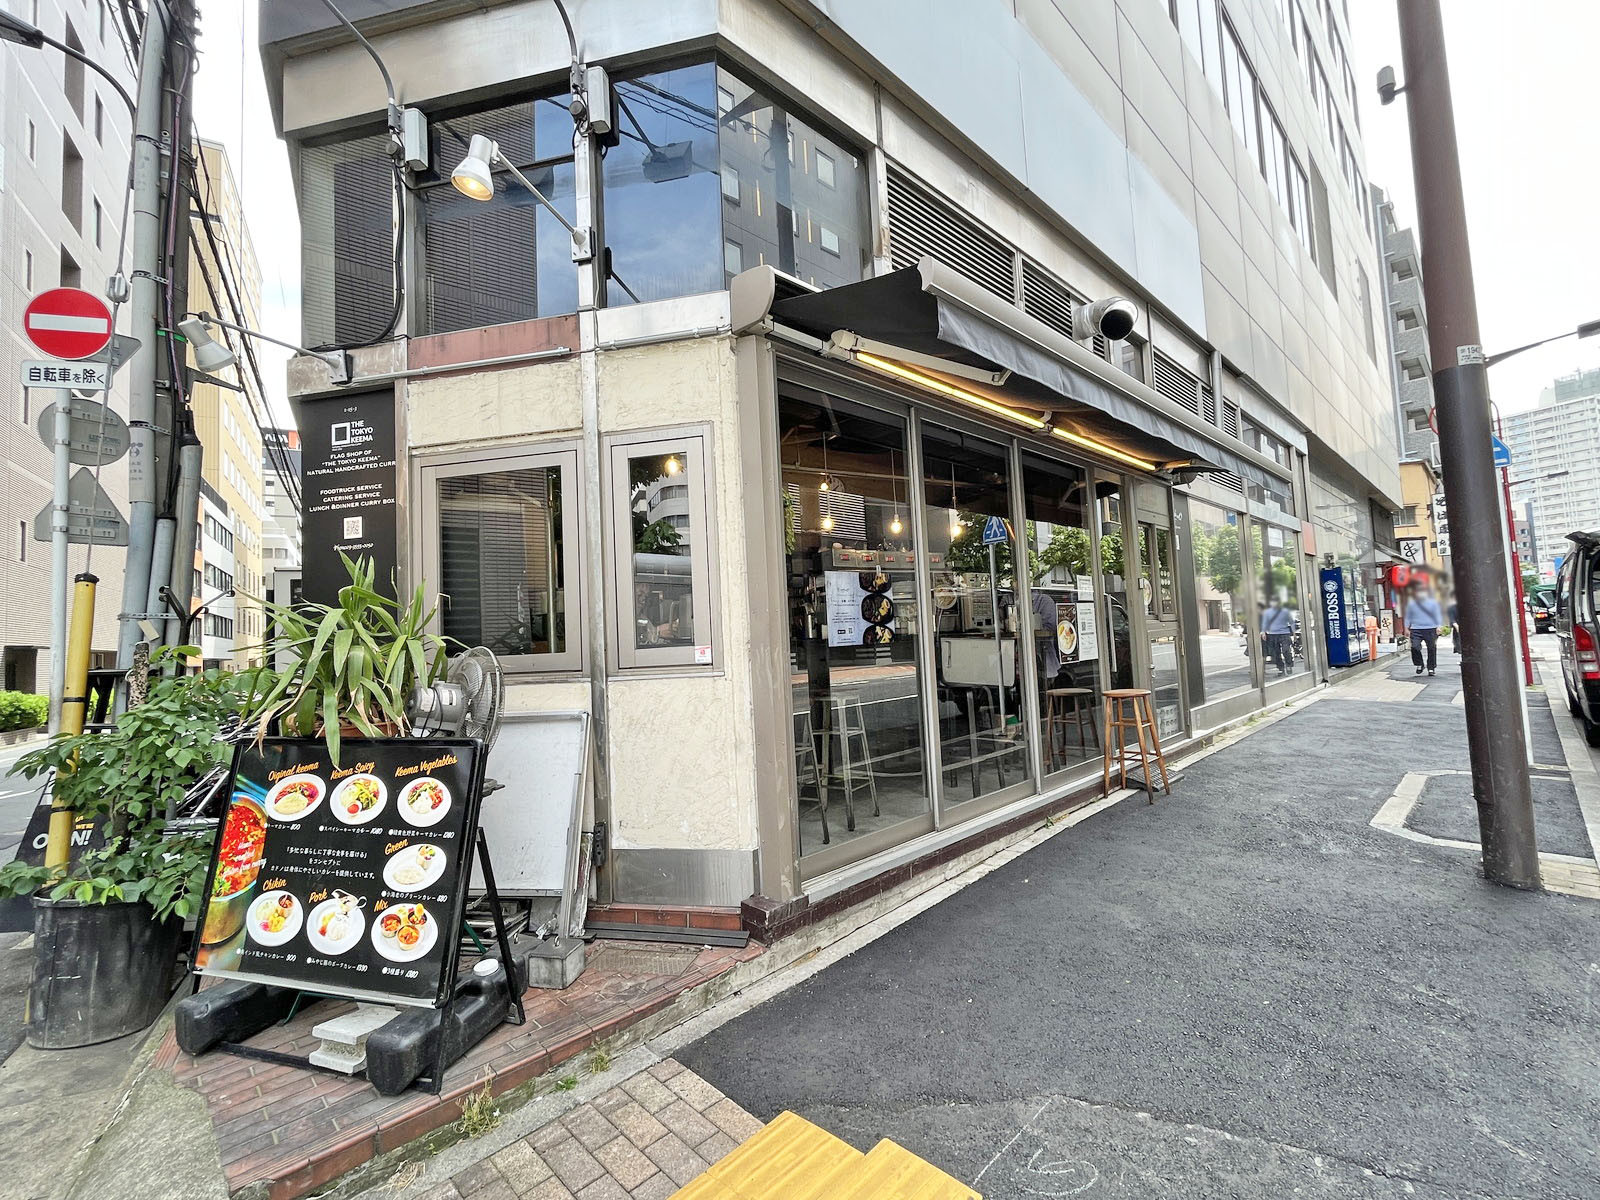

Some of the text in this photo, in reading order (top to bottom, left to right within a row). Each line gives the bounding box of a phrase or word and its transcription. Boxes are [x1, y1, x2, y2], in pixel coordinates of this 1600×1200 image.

[29, 366, 104, 384] 自転車を除く
[350, 420, 364, 428] THE
[350, 427, 373, 436] TOKYO
[350, 435, 373, 443] KEEMA
[334, 463, 378, 473] HANDCRAFTED
[320, 487, 356, 495] FOODTRUCK
[360, 500, 382, 508] CURRY
[1326, 592, 1340, 620] BOSS
[296, 762, 320, 774] keema
[330, 762, 375, 780] Keema Spicy
[395, 754, 458, 777] Keema Vegetables
[32, 830, 92, 850] ON!
[384, 839, 409, 855] Green
[263, 877, 287, 891] Chikin
[309, 888, 328, 903] Pork
[374, 899, 389, 912] Mix
